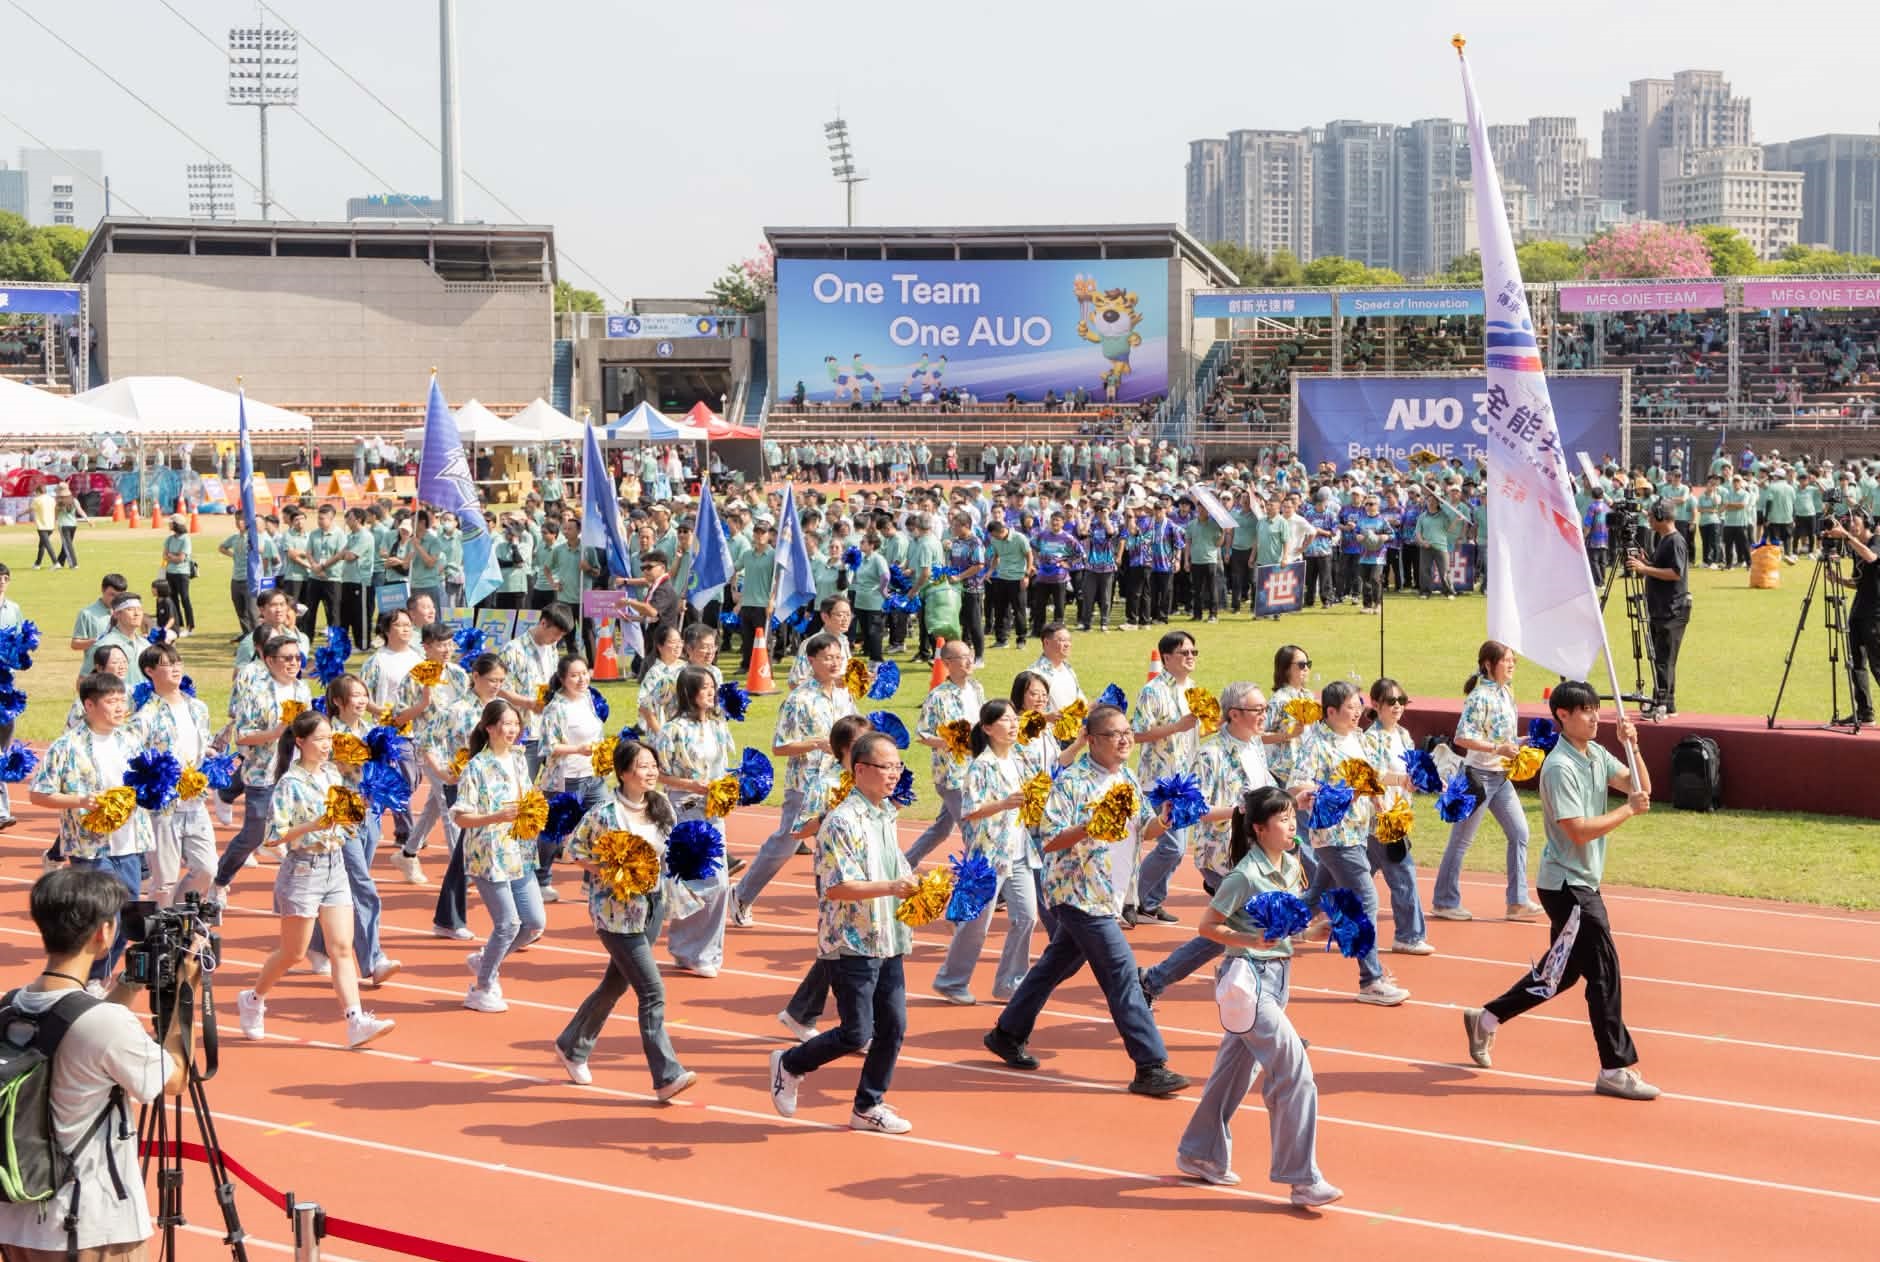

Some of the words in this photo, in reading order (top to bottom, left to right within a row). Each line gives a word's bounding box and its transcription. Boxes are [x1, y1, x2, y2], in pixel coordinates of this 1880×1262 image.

[813, 272, 884, 304] One
[892, 274, 980, 304] Team
[1771, 289, 1805, 301] MFG
[1809, 288, 1842, 301] ONE
[1846, 287, 1880, 301] TEA
[1355, 300, 1390, 312] Speed
[1393, 299, 1405, 309] of
[1407, 298, 1469, 310] Innovation
[1586, 294, 1618, 305] MFG
[1622, 293, 1653, 305] ONE
[1656, 291, 1697, 304] TEAM
[627, 319, 639, 333] 4
[889, 316, 960, 347] One
[966, 316, 1052, 346] AUO
[660, 343, 670, 355] 4
[1384, 397, 1464, 431] AUO
[1471, 393, 1488, 434] 3
[1348, 442, 1371, 459] Be
[1374, 443, 1405, 459] the
[1463, 443, 1488, 461] Te
[1265, 571, 1298, 606] 世
